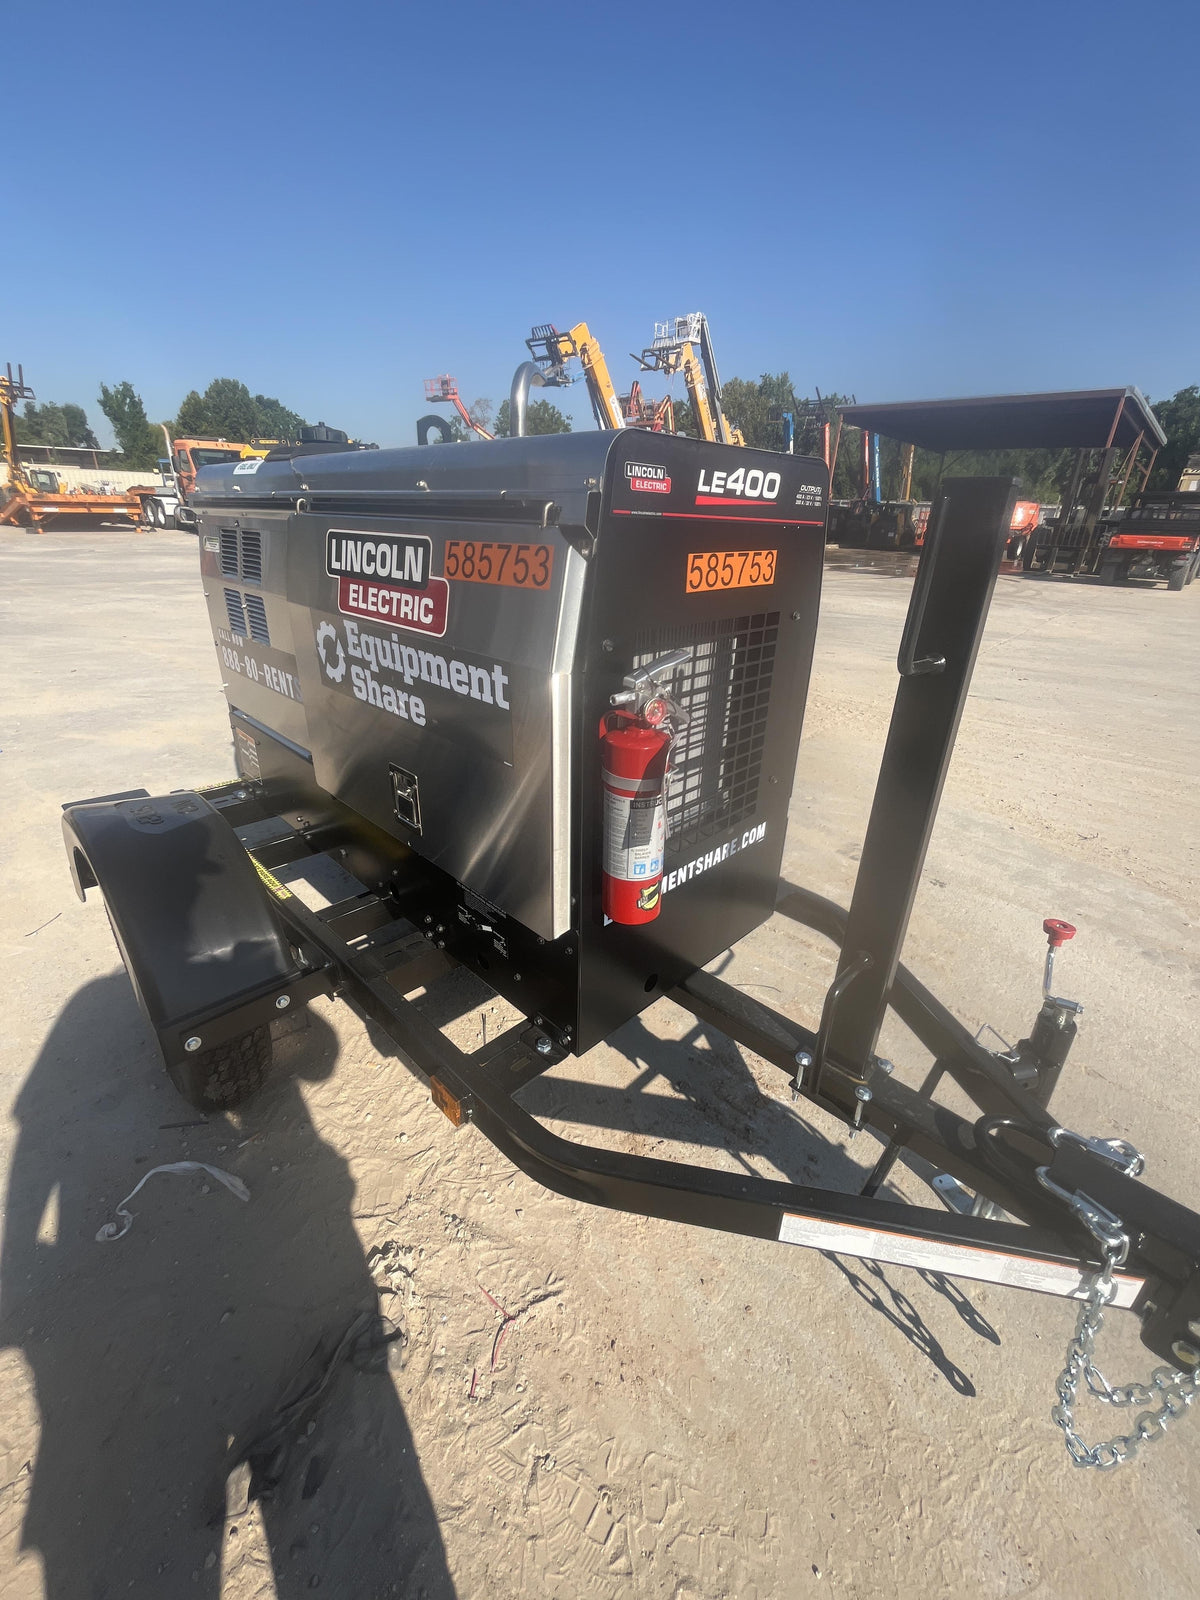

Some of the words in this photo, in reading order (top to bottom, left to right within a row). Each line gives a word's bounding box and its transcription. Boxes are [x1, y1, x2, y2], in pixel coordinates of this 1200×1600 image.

[627, 465, 664, 479] LINCOLN
[635, 480, 667, 491] ELECTRIC
[697, 467, 781, 499] LE400
[331, 538, 424, 582] LINCOLN
[446, 541, 549, 586] 585753
[689, 551, 775, 590] 585753
[348, 583, 434, 624] ELECTRIC
[343, 619, 510, 711] Equipment
[350, 664, 427, 727] Share
[632, 798, 663, 808] INSTRUC
